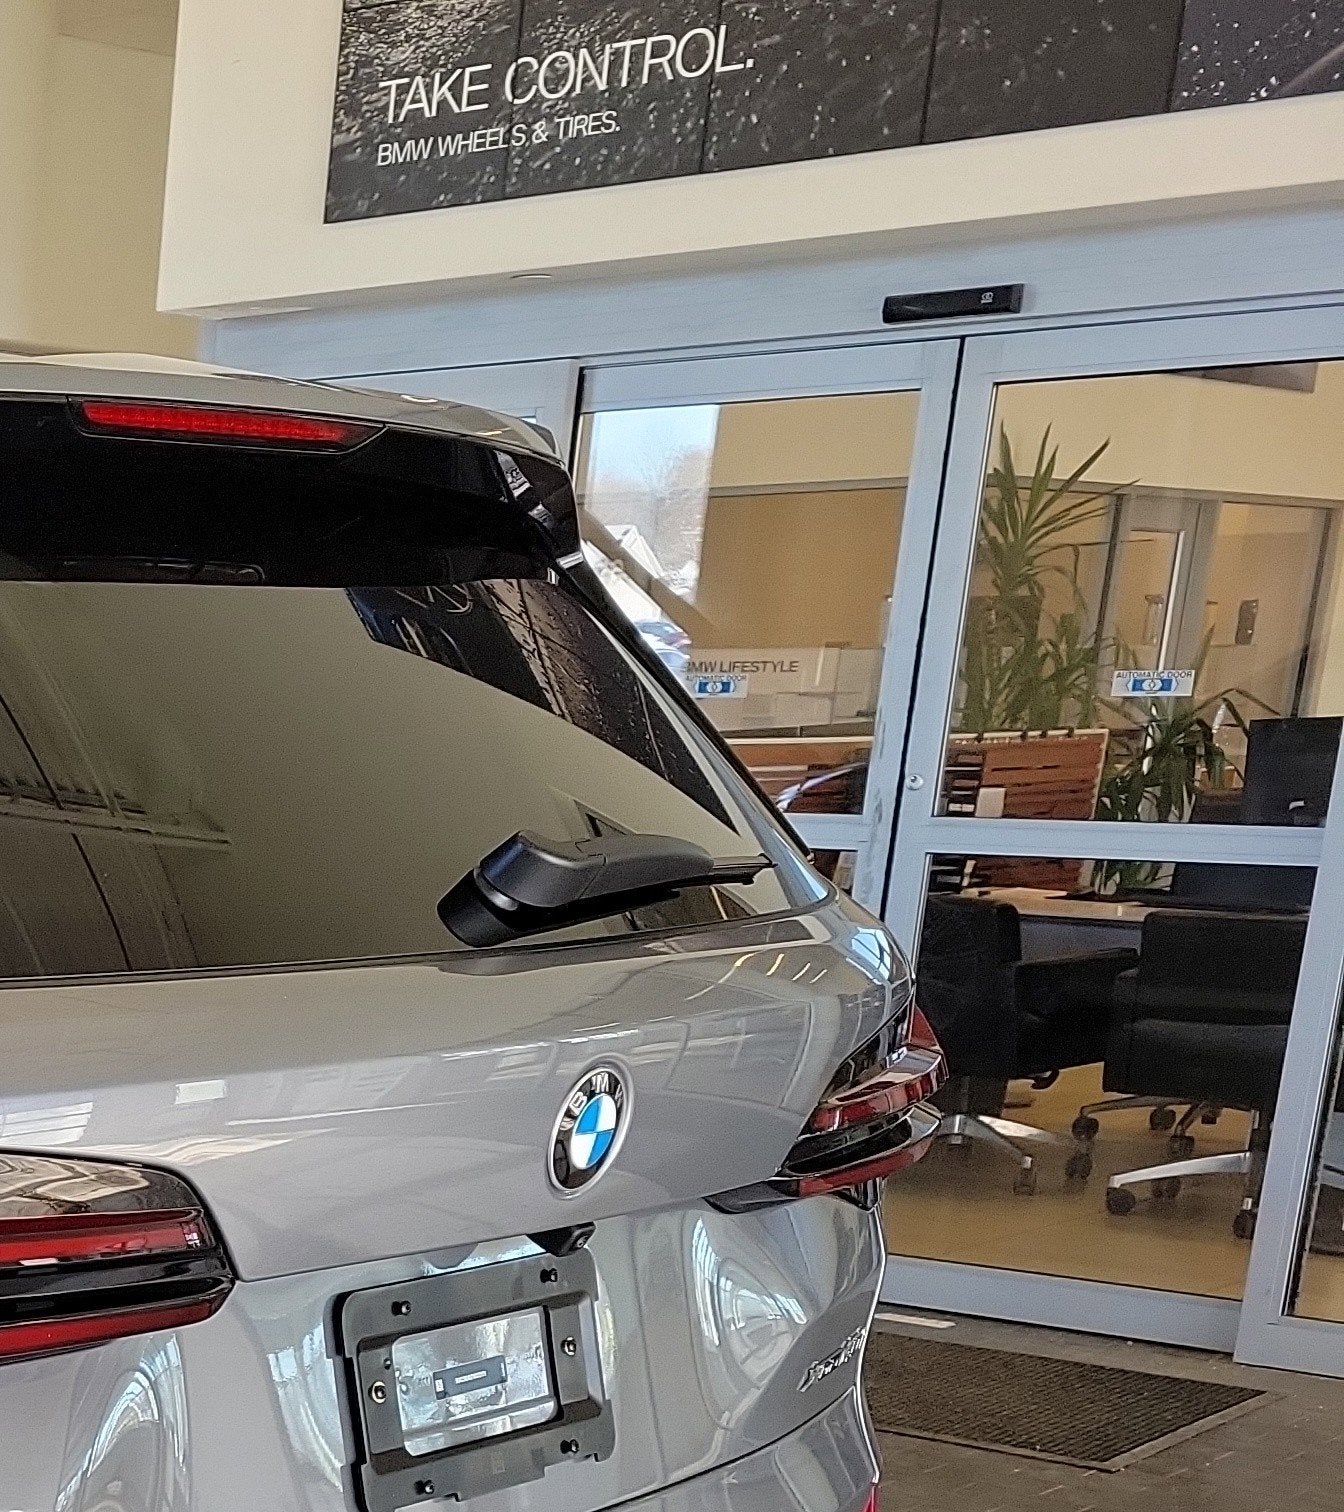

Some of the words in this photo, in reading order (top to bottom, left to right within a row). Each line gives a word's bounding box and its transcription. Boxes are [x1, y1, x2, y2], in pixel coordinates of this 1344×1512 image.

[377, 63, 493, 125] TAKE
[504, 24, 755, 105] CONTROL.
[376, 136, 435, 166] BMW
[438, 123, 527, 158] WHEELS
[531, 120, 549, 144] &
[557, 110, 622, 141] TIRES.
[719, 660, 800, 673] LIFESTYLE
[568, 1070, 625, 1117] BMW
